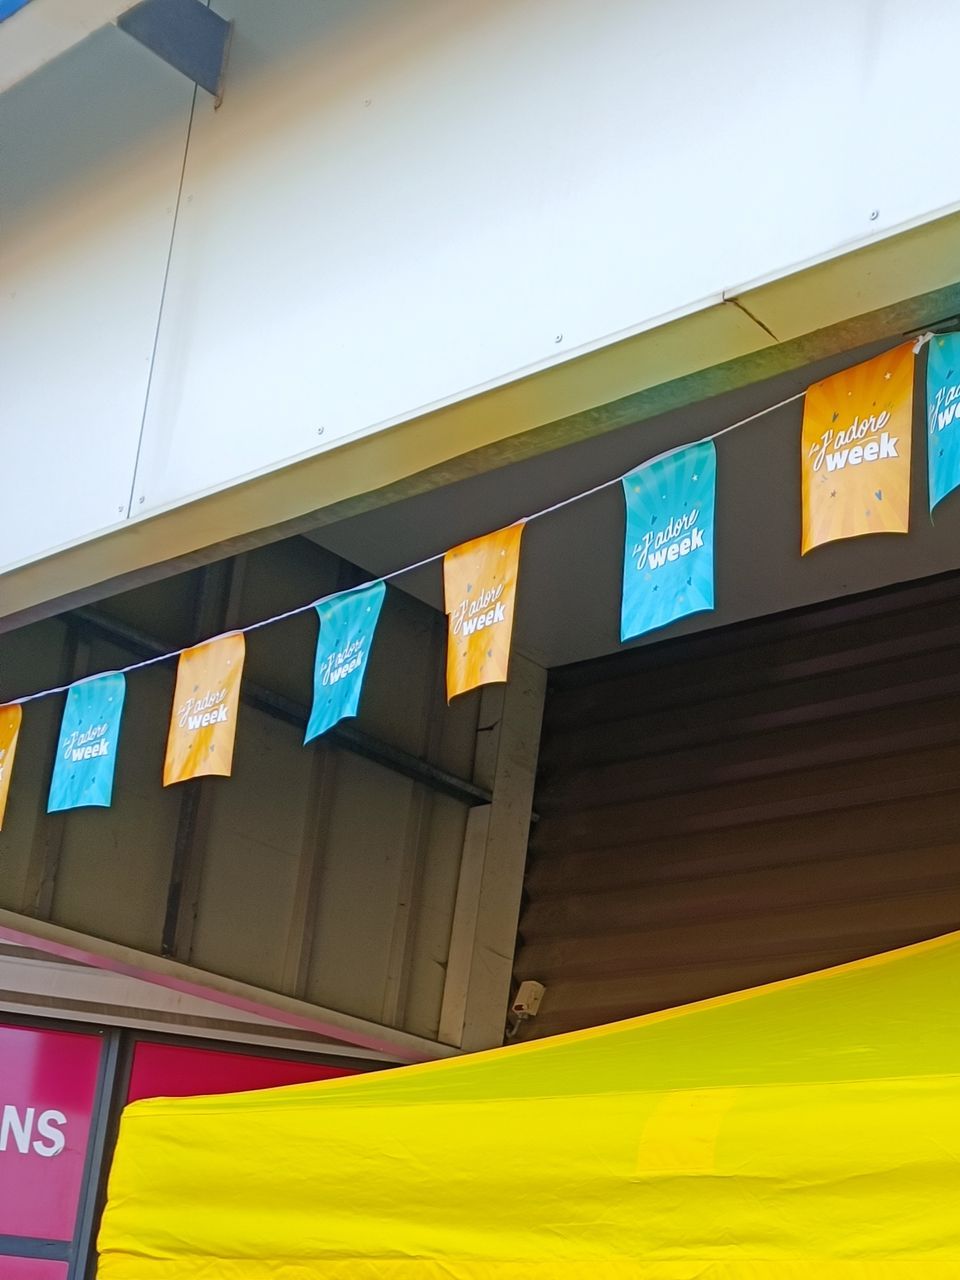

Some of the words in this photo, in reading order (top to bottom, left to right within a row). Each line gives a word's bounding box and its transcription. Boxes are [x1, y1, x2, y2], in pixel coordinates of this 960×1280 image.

[813, 410, 890, 472] J'adore
[825, 431, 899, 472] week
[637, 508, 700, 570] J'adore
[647, 526, 705, 570] week
[462, 600, 506, 637] week
[329, 649, 365, 686] week
[188, 703, 229, 730] week
[72, 737, 110, 762] week
[0, 1104, 68, 1158] NS
